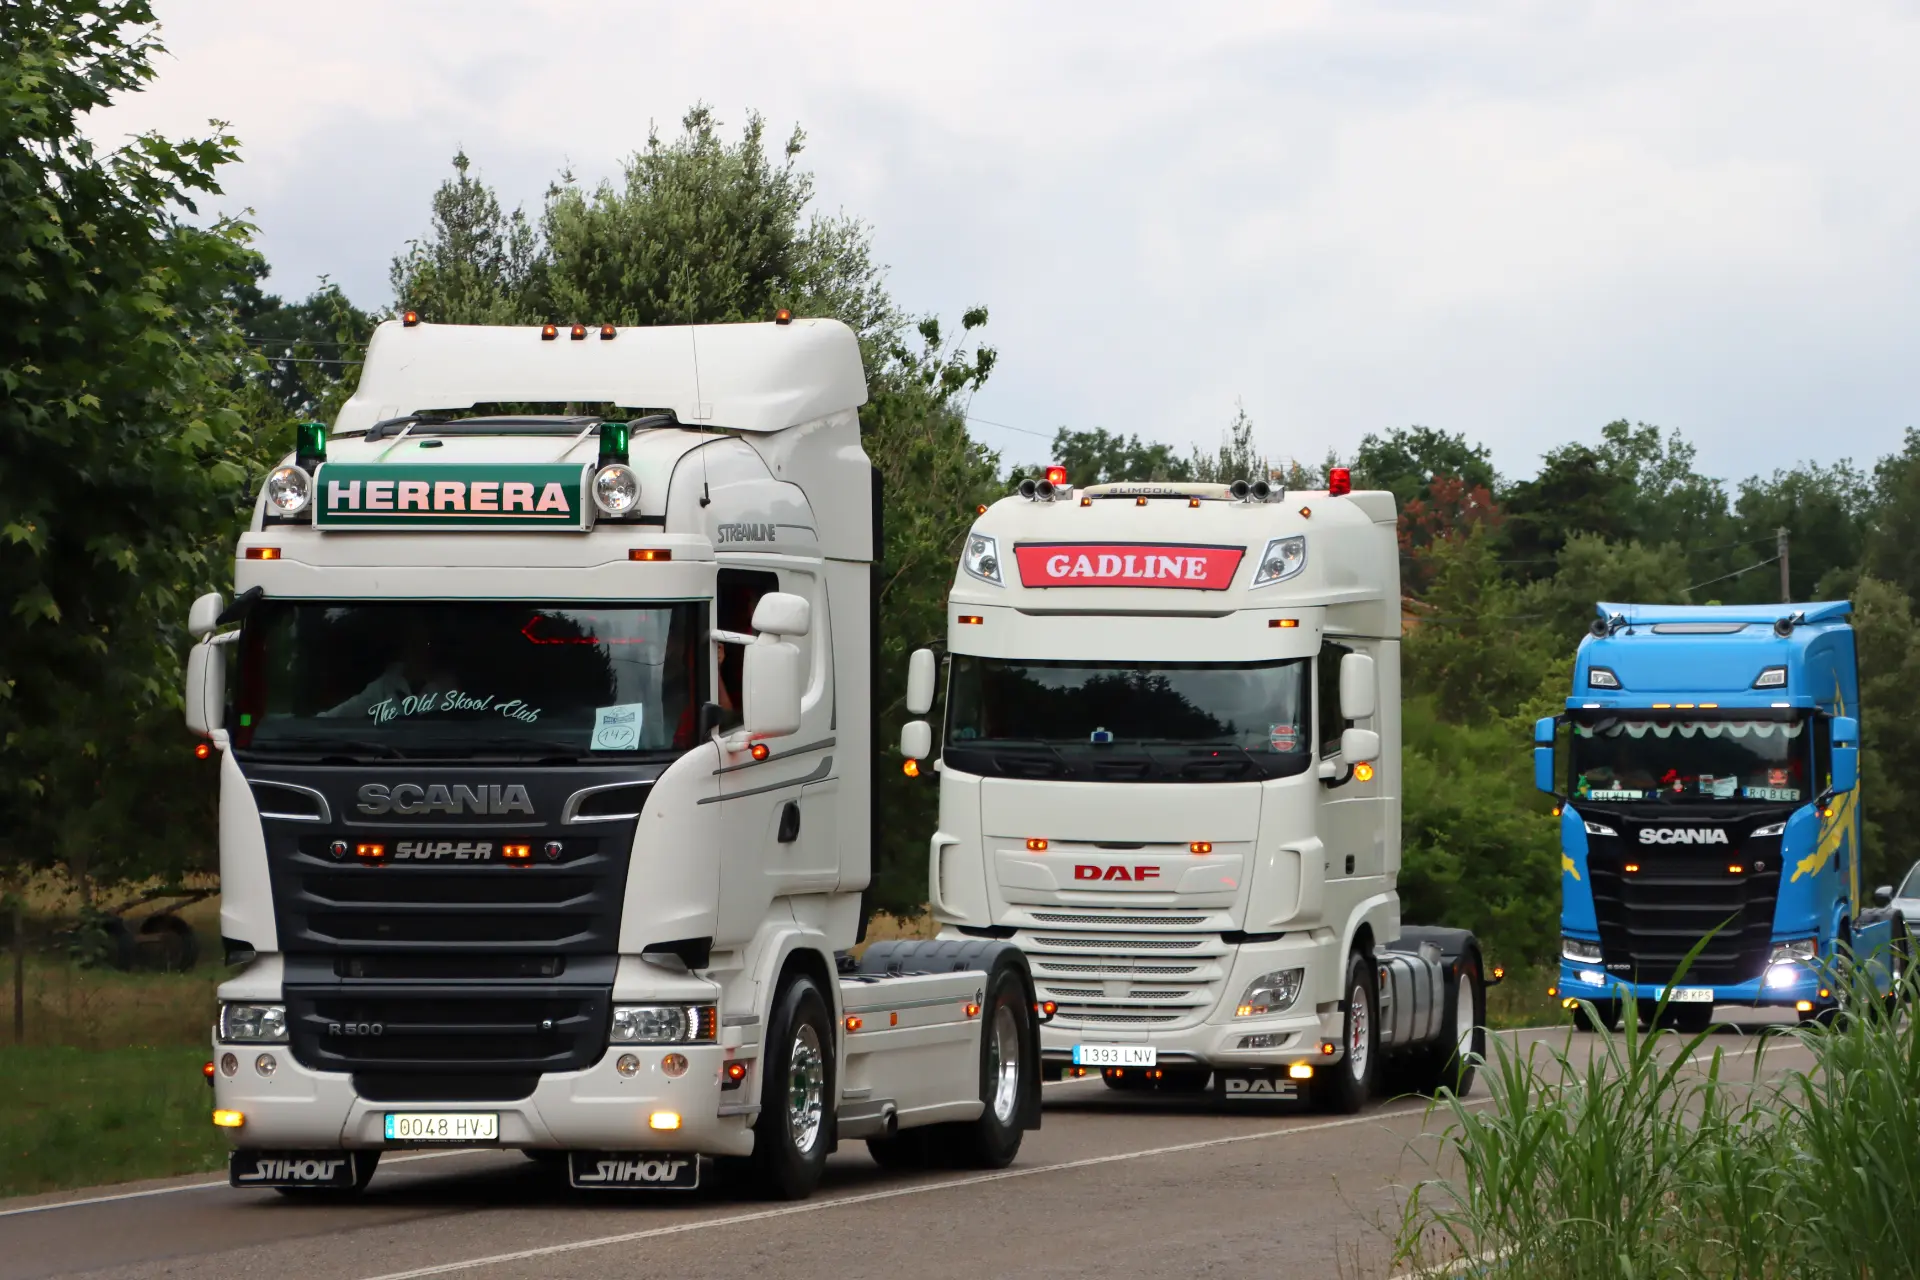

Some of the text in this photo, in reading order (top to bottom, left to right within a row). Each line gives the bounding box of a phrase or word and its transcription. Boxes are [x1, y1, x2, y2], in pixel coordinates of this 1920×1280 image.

[327, 480, 570, 512] HERRERA
[717, 523, 776, 544] STREAMLINE
[1046, 554, 1207, 580] GADLINE
[368, 690, 541, 726] The Old Skool Club
[601, 729, 631, 741] 147
[356, 783, 535, 815] SCANIA
[1639, 828, 1729, 844] SCANIA
[394, 842, 493, 860] SUPER
[1074, 864, 1160, 881] DAF
[1691, 990, 1711, 1000] KPS
[328, 1023, 383, 1035] R 500
[1084, 1048, 1152, 1063] 1393 LNV
[1225, 1079, 1298, 1093] DAF
[400, 1118, 493, 1136] 0048 HVJ
